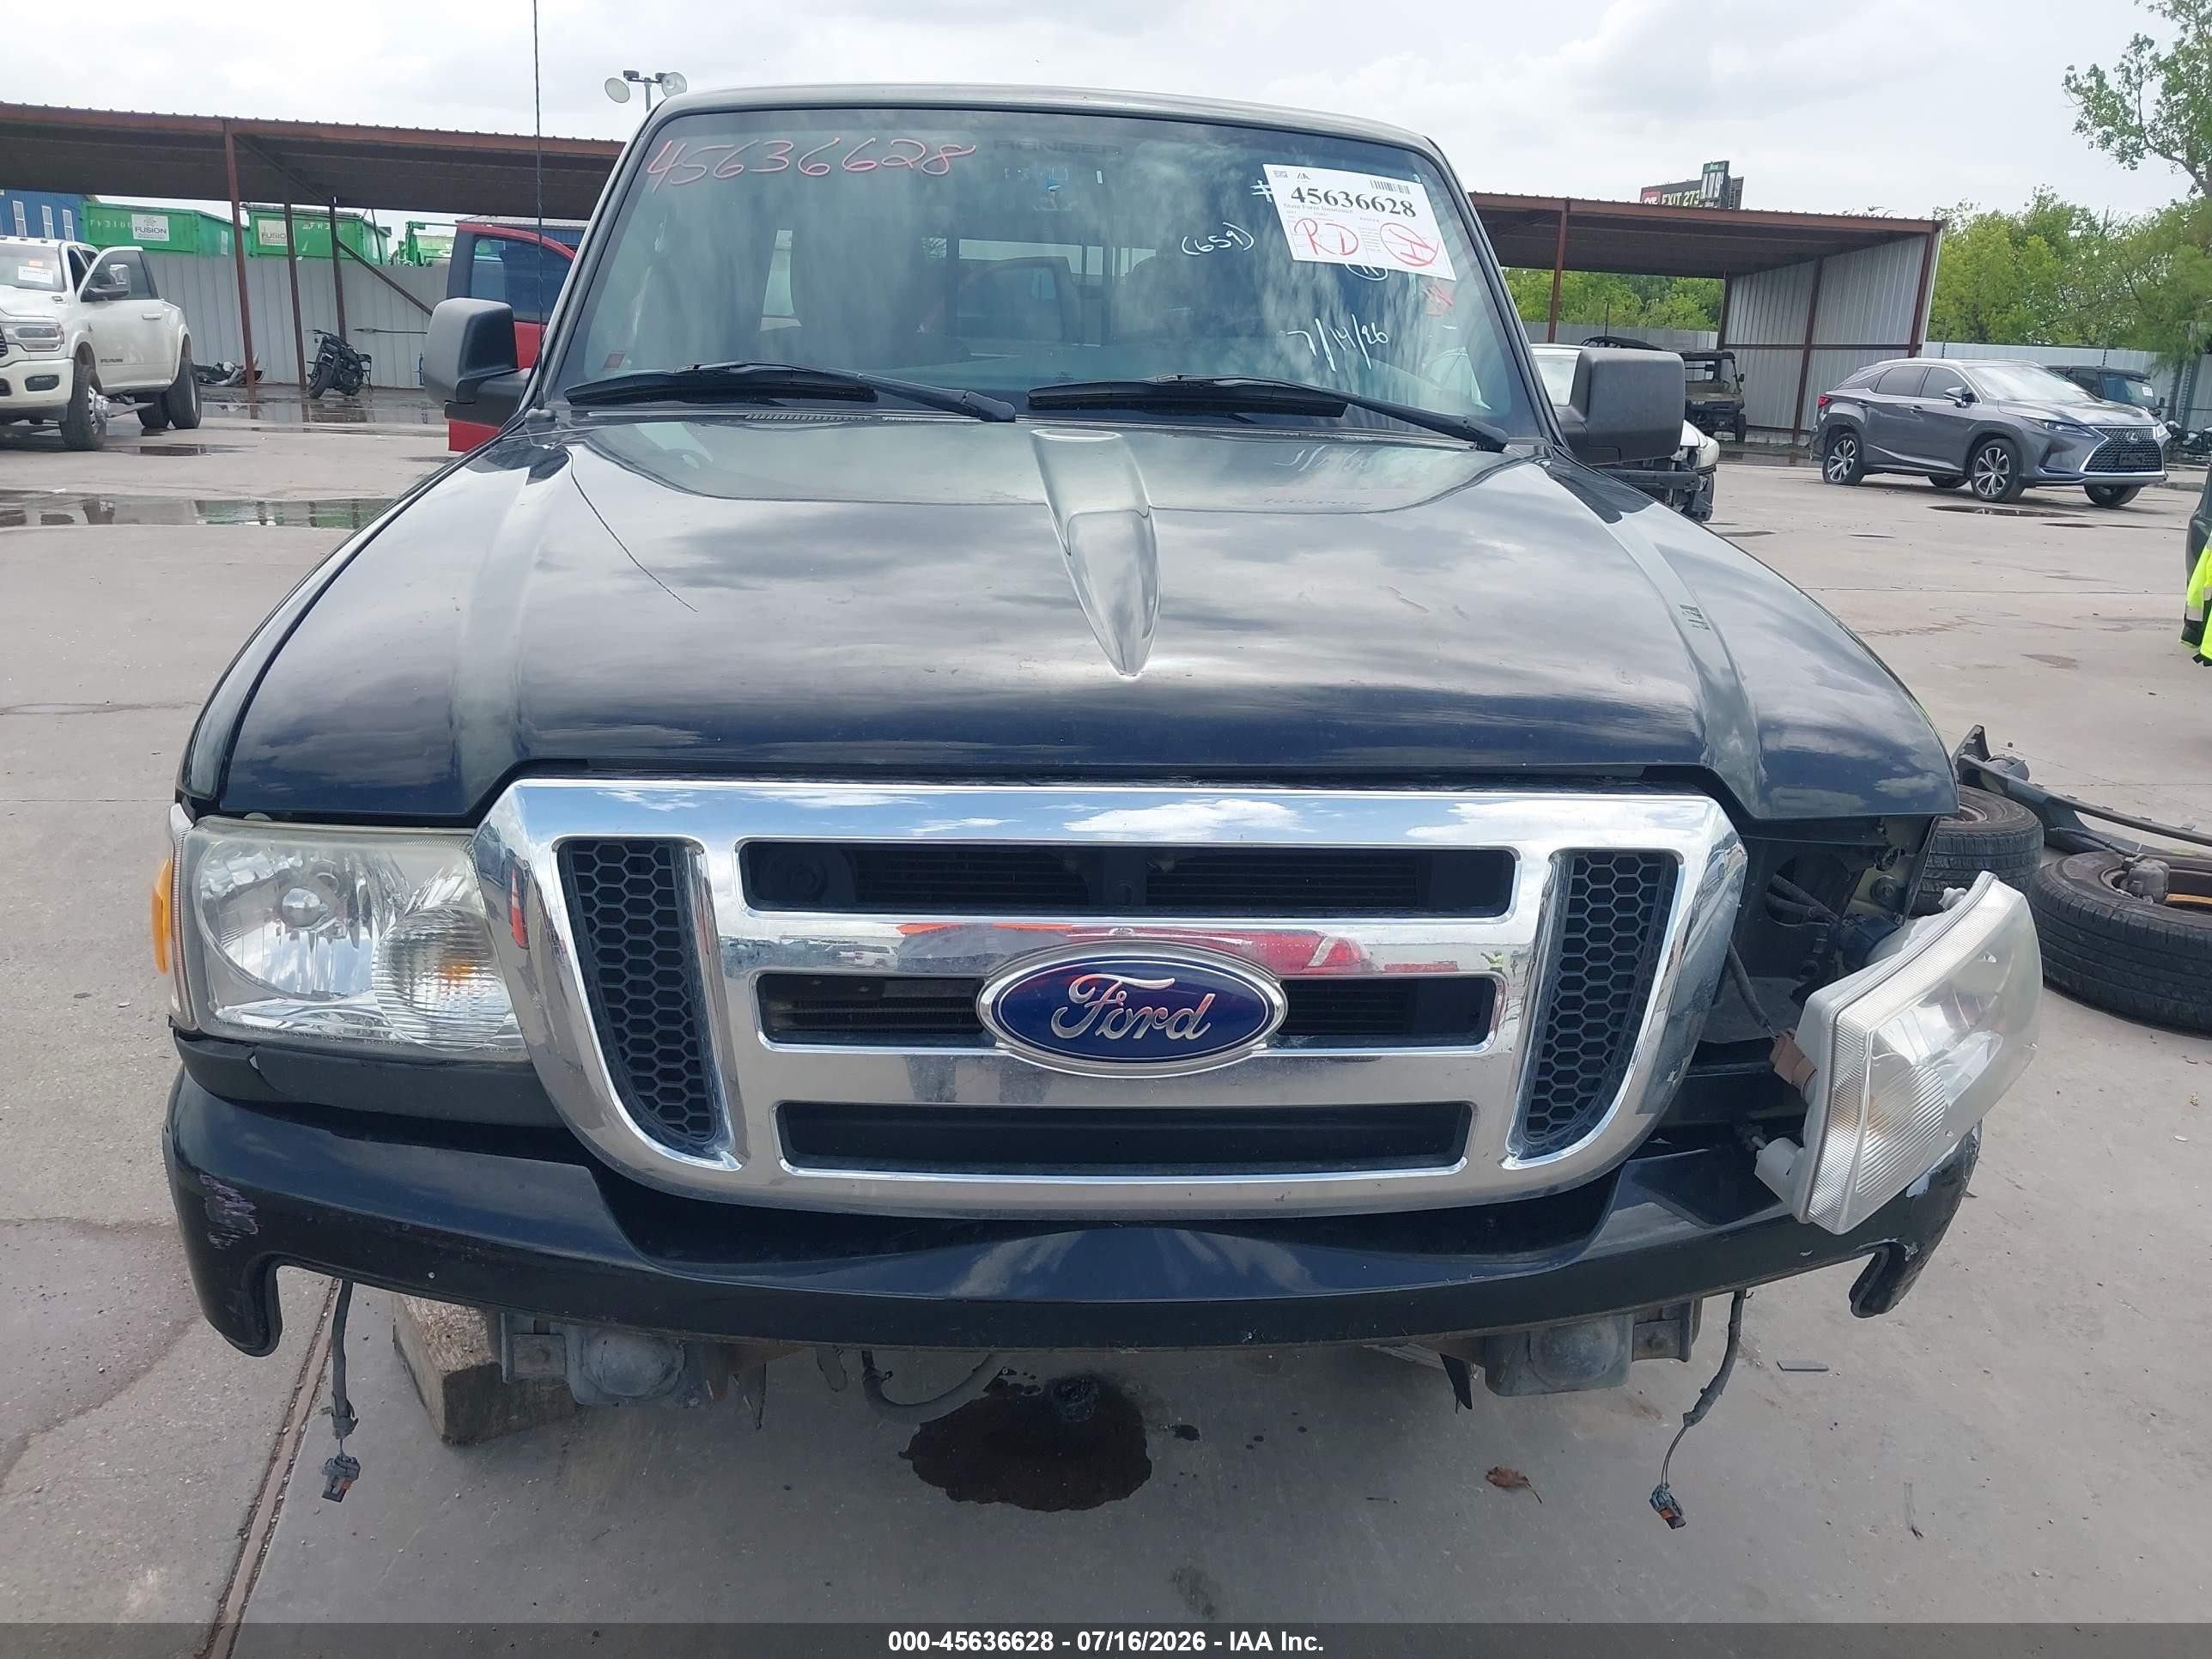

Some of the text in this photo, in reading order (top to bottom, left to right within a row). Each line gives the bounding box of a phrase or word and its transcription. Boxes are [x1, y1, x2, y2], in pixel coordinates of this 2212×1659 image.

[647, 136, 976, 194] 45636628
[135, 226, 167, 234] FUSION
[1291, 186, 1417, 218] 45636628
[1286, 313, 1389, 372] 7/14/26
[1050, 973, 1215, 1040] Ford
